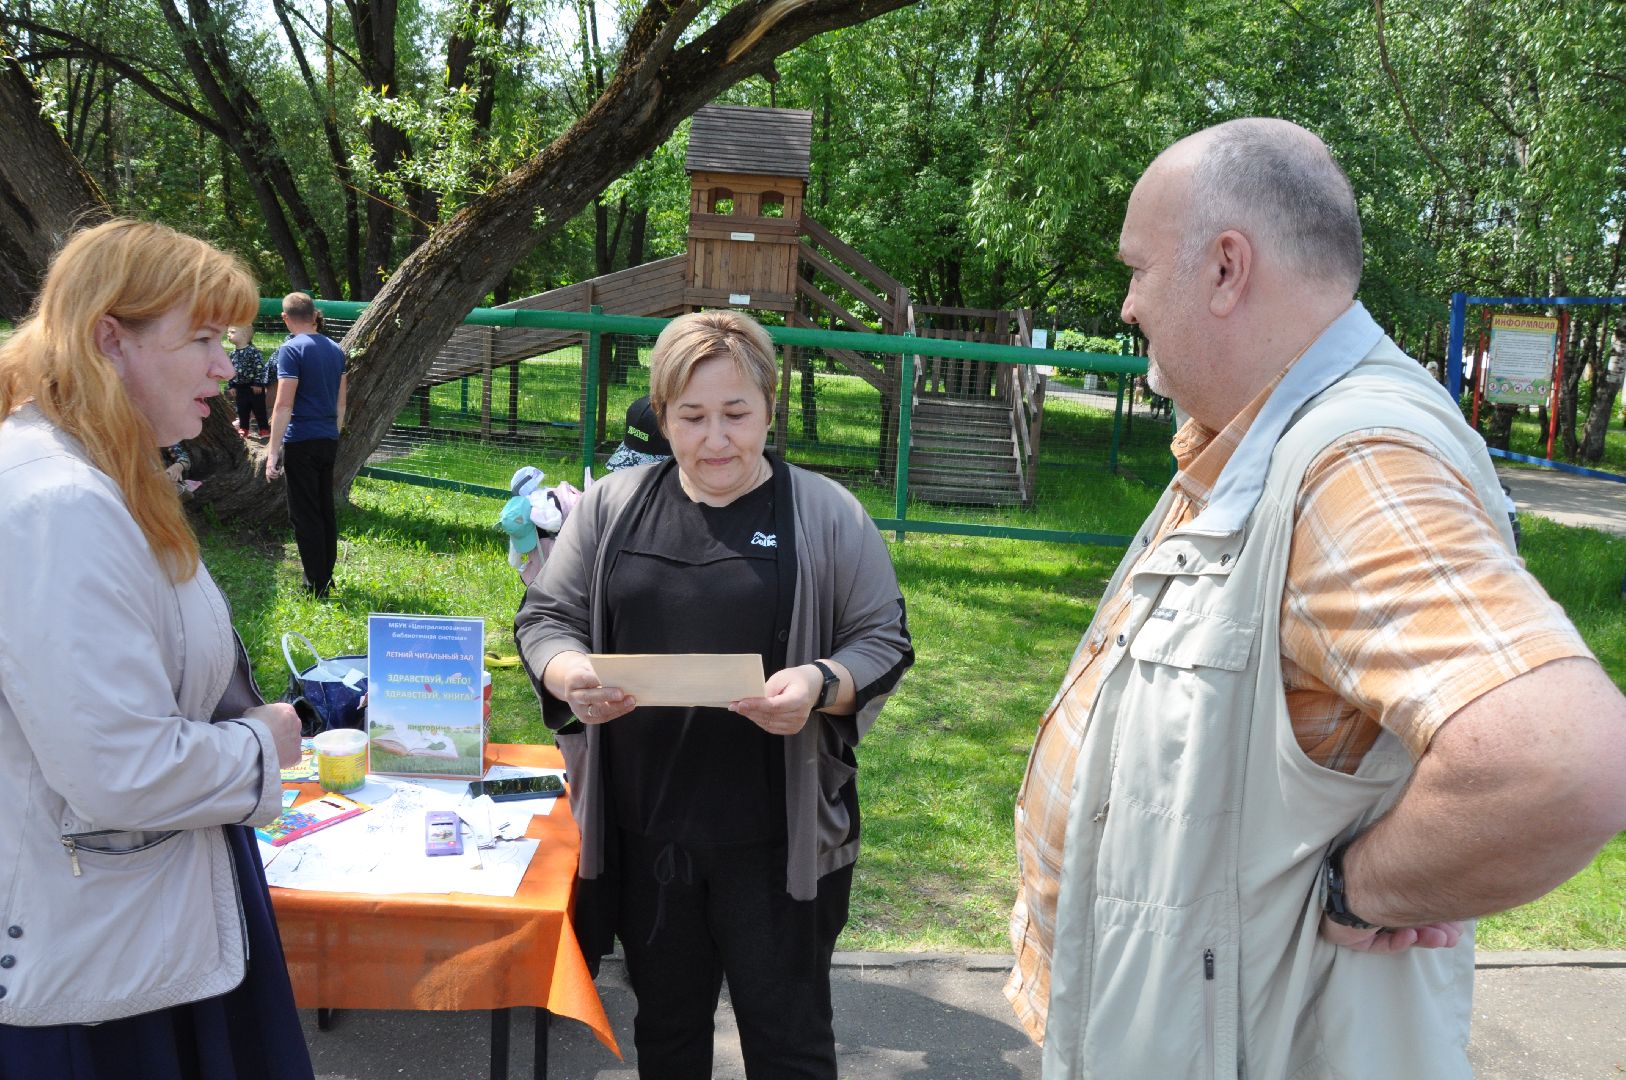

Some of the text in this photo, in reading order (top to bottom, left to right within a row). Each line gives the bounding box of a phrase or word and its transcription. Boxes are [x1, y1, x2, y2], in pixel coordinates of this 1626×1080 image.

[1494, 318, 1555, 329] ИНФОРМАЦИЯ
[386, 650, 414, 658] ЛЕТНИЙ
[414, 652, 459, 660] ЧИТАЛЬНЫЙ
[387, 674, 444, 685] ЗДРАВСТВУЙ,
